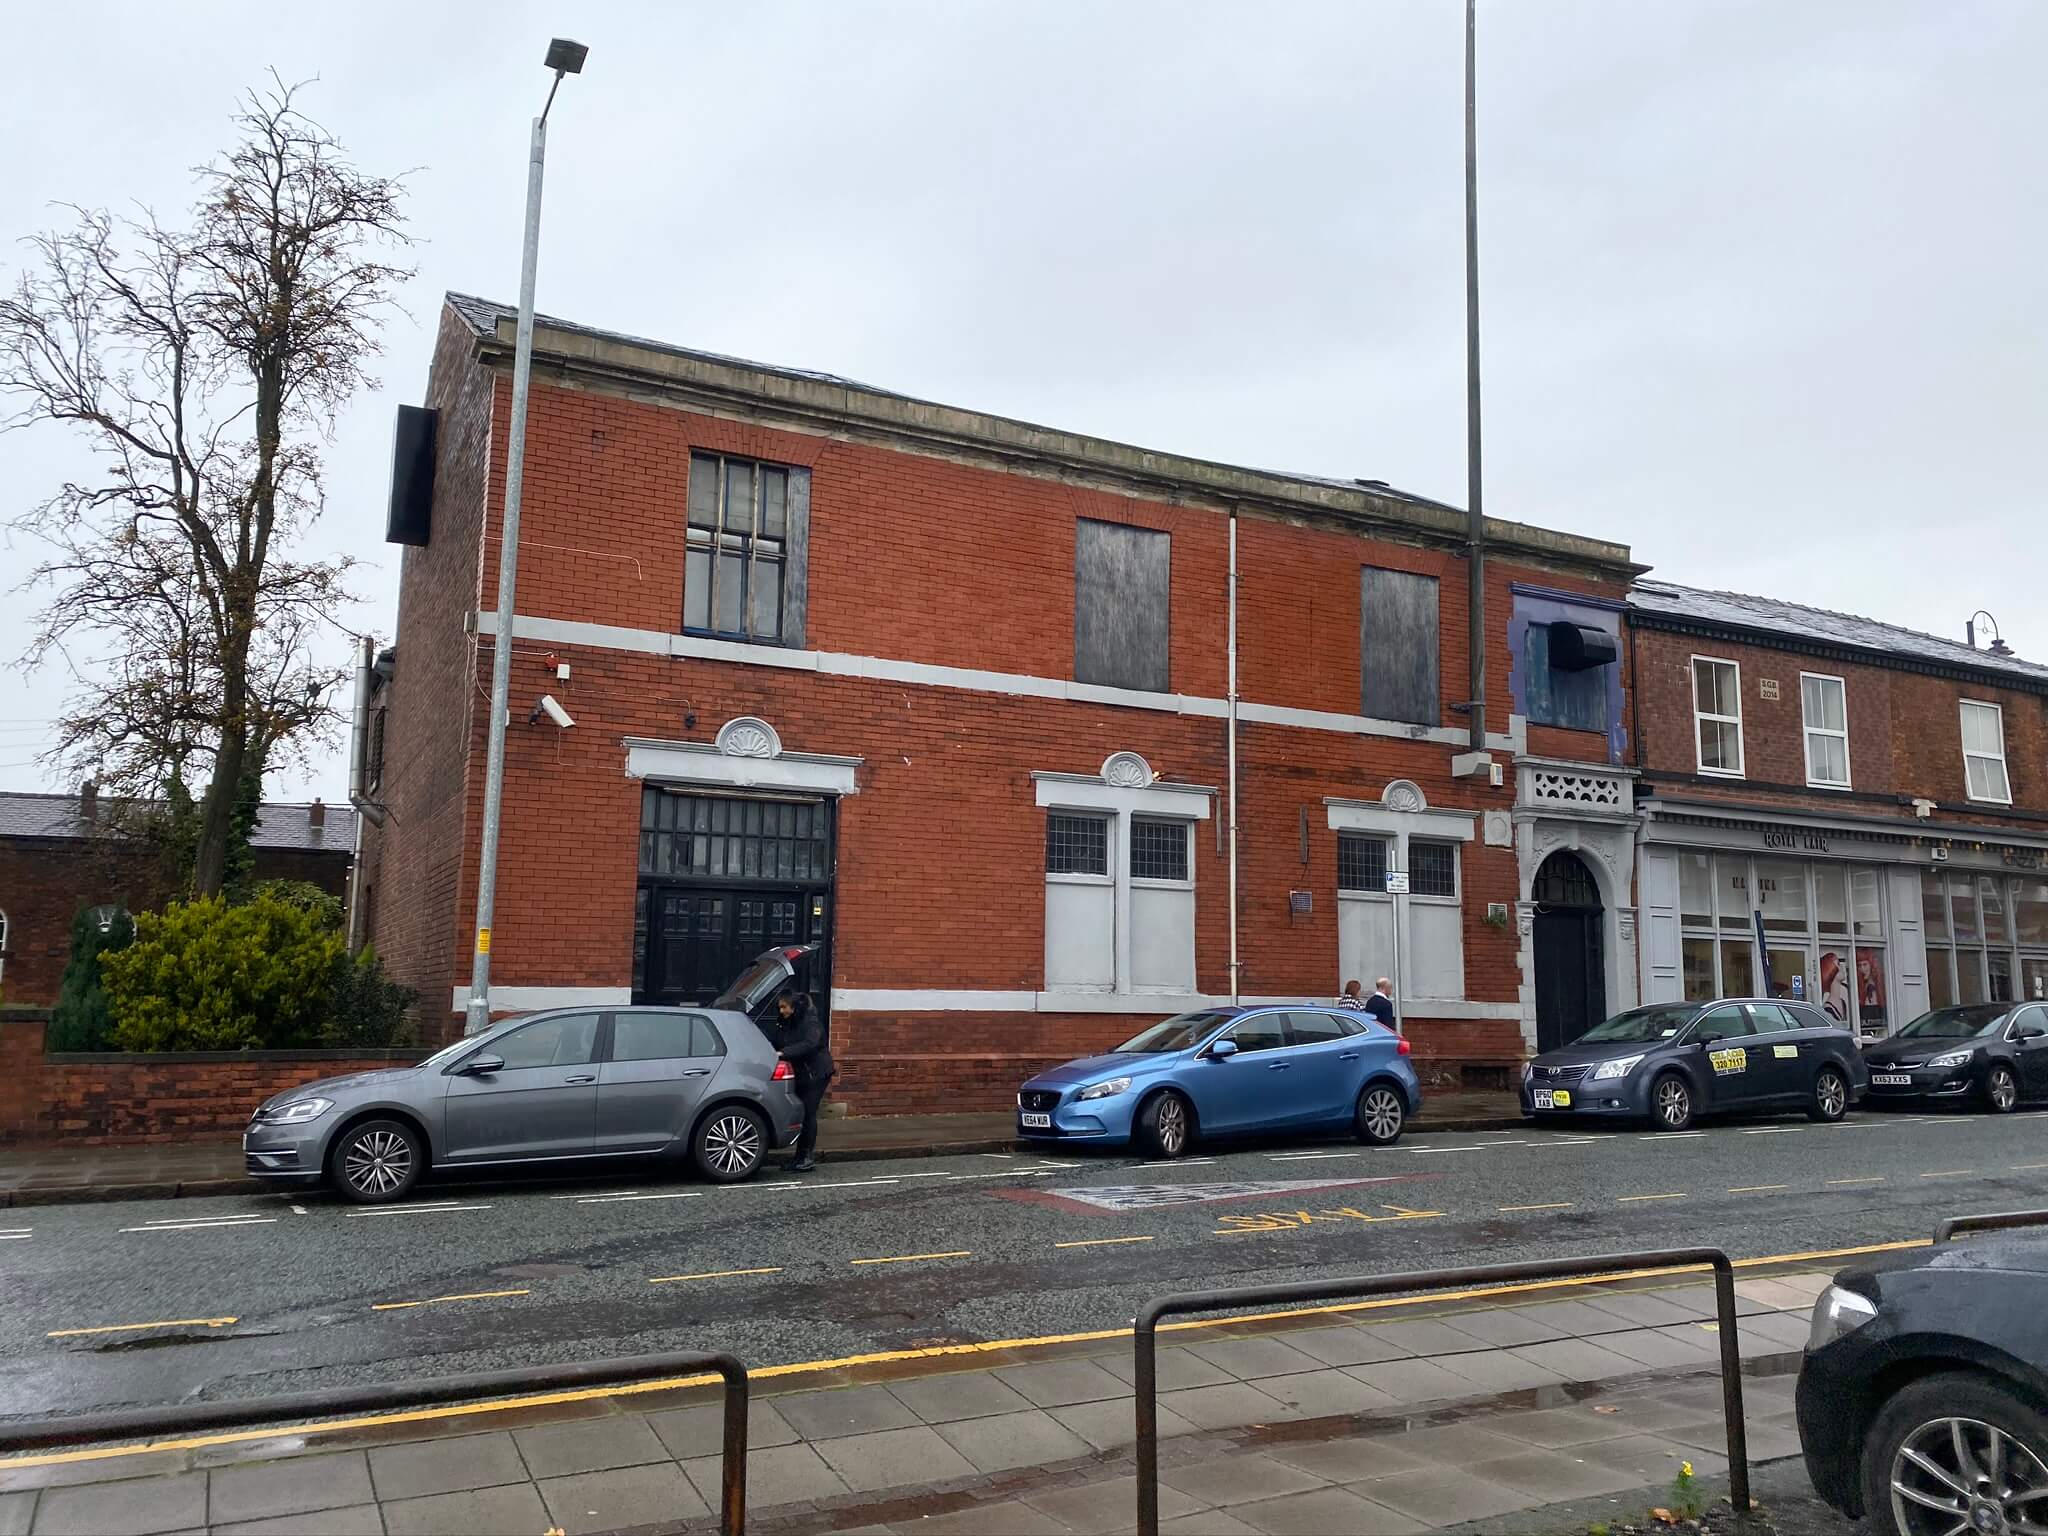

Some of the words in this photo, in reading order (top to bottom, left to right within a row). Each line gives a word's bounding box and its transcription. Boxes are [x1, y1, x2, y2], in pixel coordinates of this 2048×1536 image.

[1715, 1060, 1728, 1069] 320
[1728, 1057, 1743, 1067] 7117
[1893, 1075, 1907, 1083] XXS
